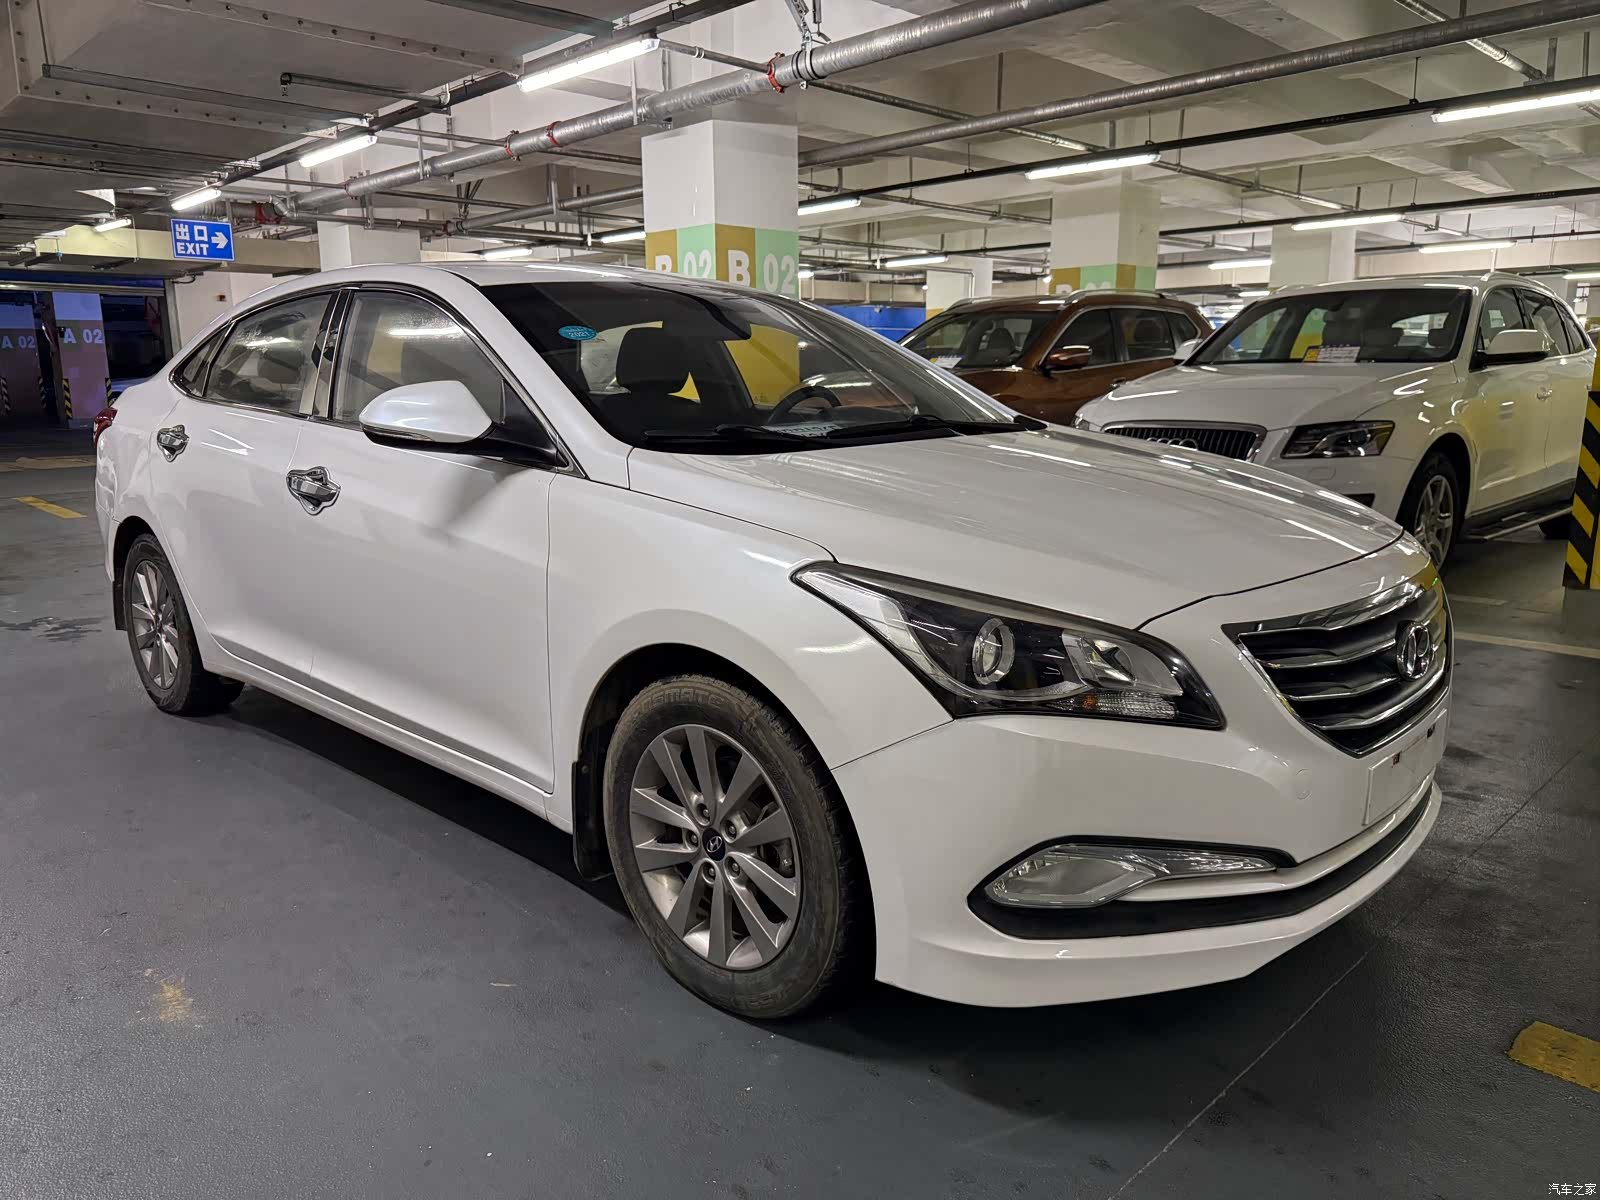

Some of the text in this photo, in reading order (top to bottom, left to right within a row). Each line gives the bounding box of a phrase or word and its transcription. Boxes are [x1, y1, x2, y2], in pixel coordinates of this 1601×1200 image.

[175, 223, 208, 241] 出口
[176, 242, 209, 255] EXIT
[728, 249, 795, 294] B 02
[1, 335, 36, 348] A 02
[63, 327, 104, 344] A 02
